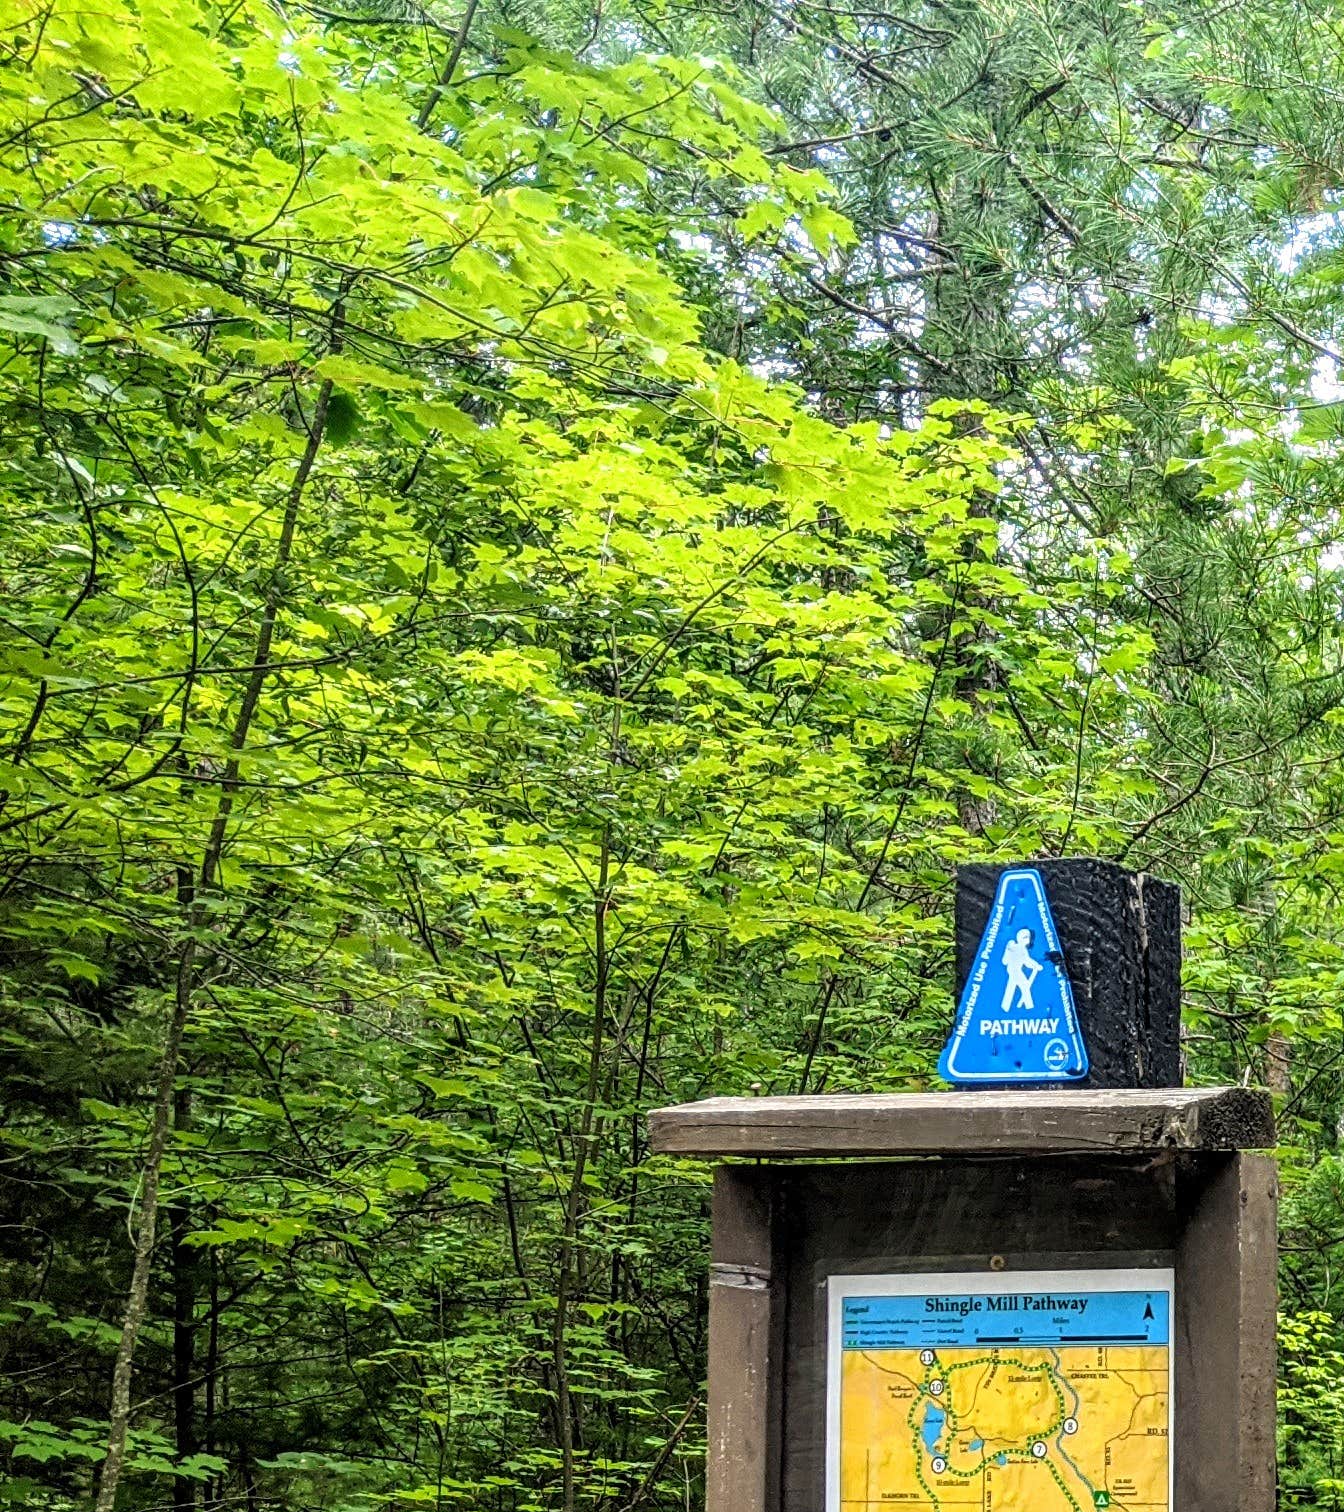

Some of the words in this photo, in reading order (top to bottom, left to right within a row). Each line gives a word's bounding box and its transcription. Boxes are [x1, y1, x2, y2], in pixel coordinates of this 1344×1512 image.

[958, 983, 981, 1036] Motorized
[974, 963, 988, 987] Use
[984, 904, 1004, 960] Prohibited
[1056, 978, 1075, 1033] Prohibited
[980, 1018, 1060, 1035] PATHWAY
[925, 1298, 982, 1316] Shingle
[986, 1296, 1018, 1310] Mill
[1023, 1295, 1088, 1314] Pathway
